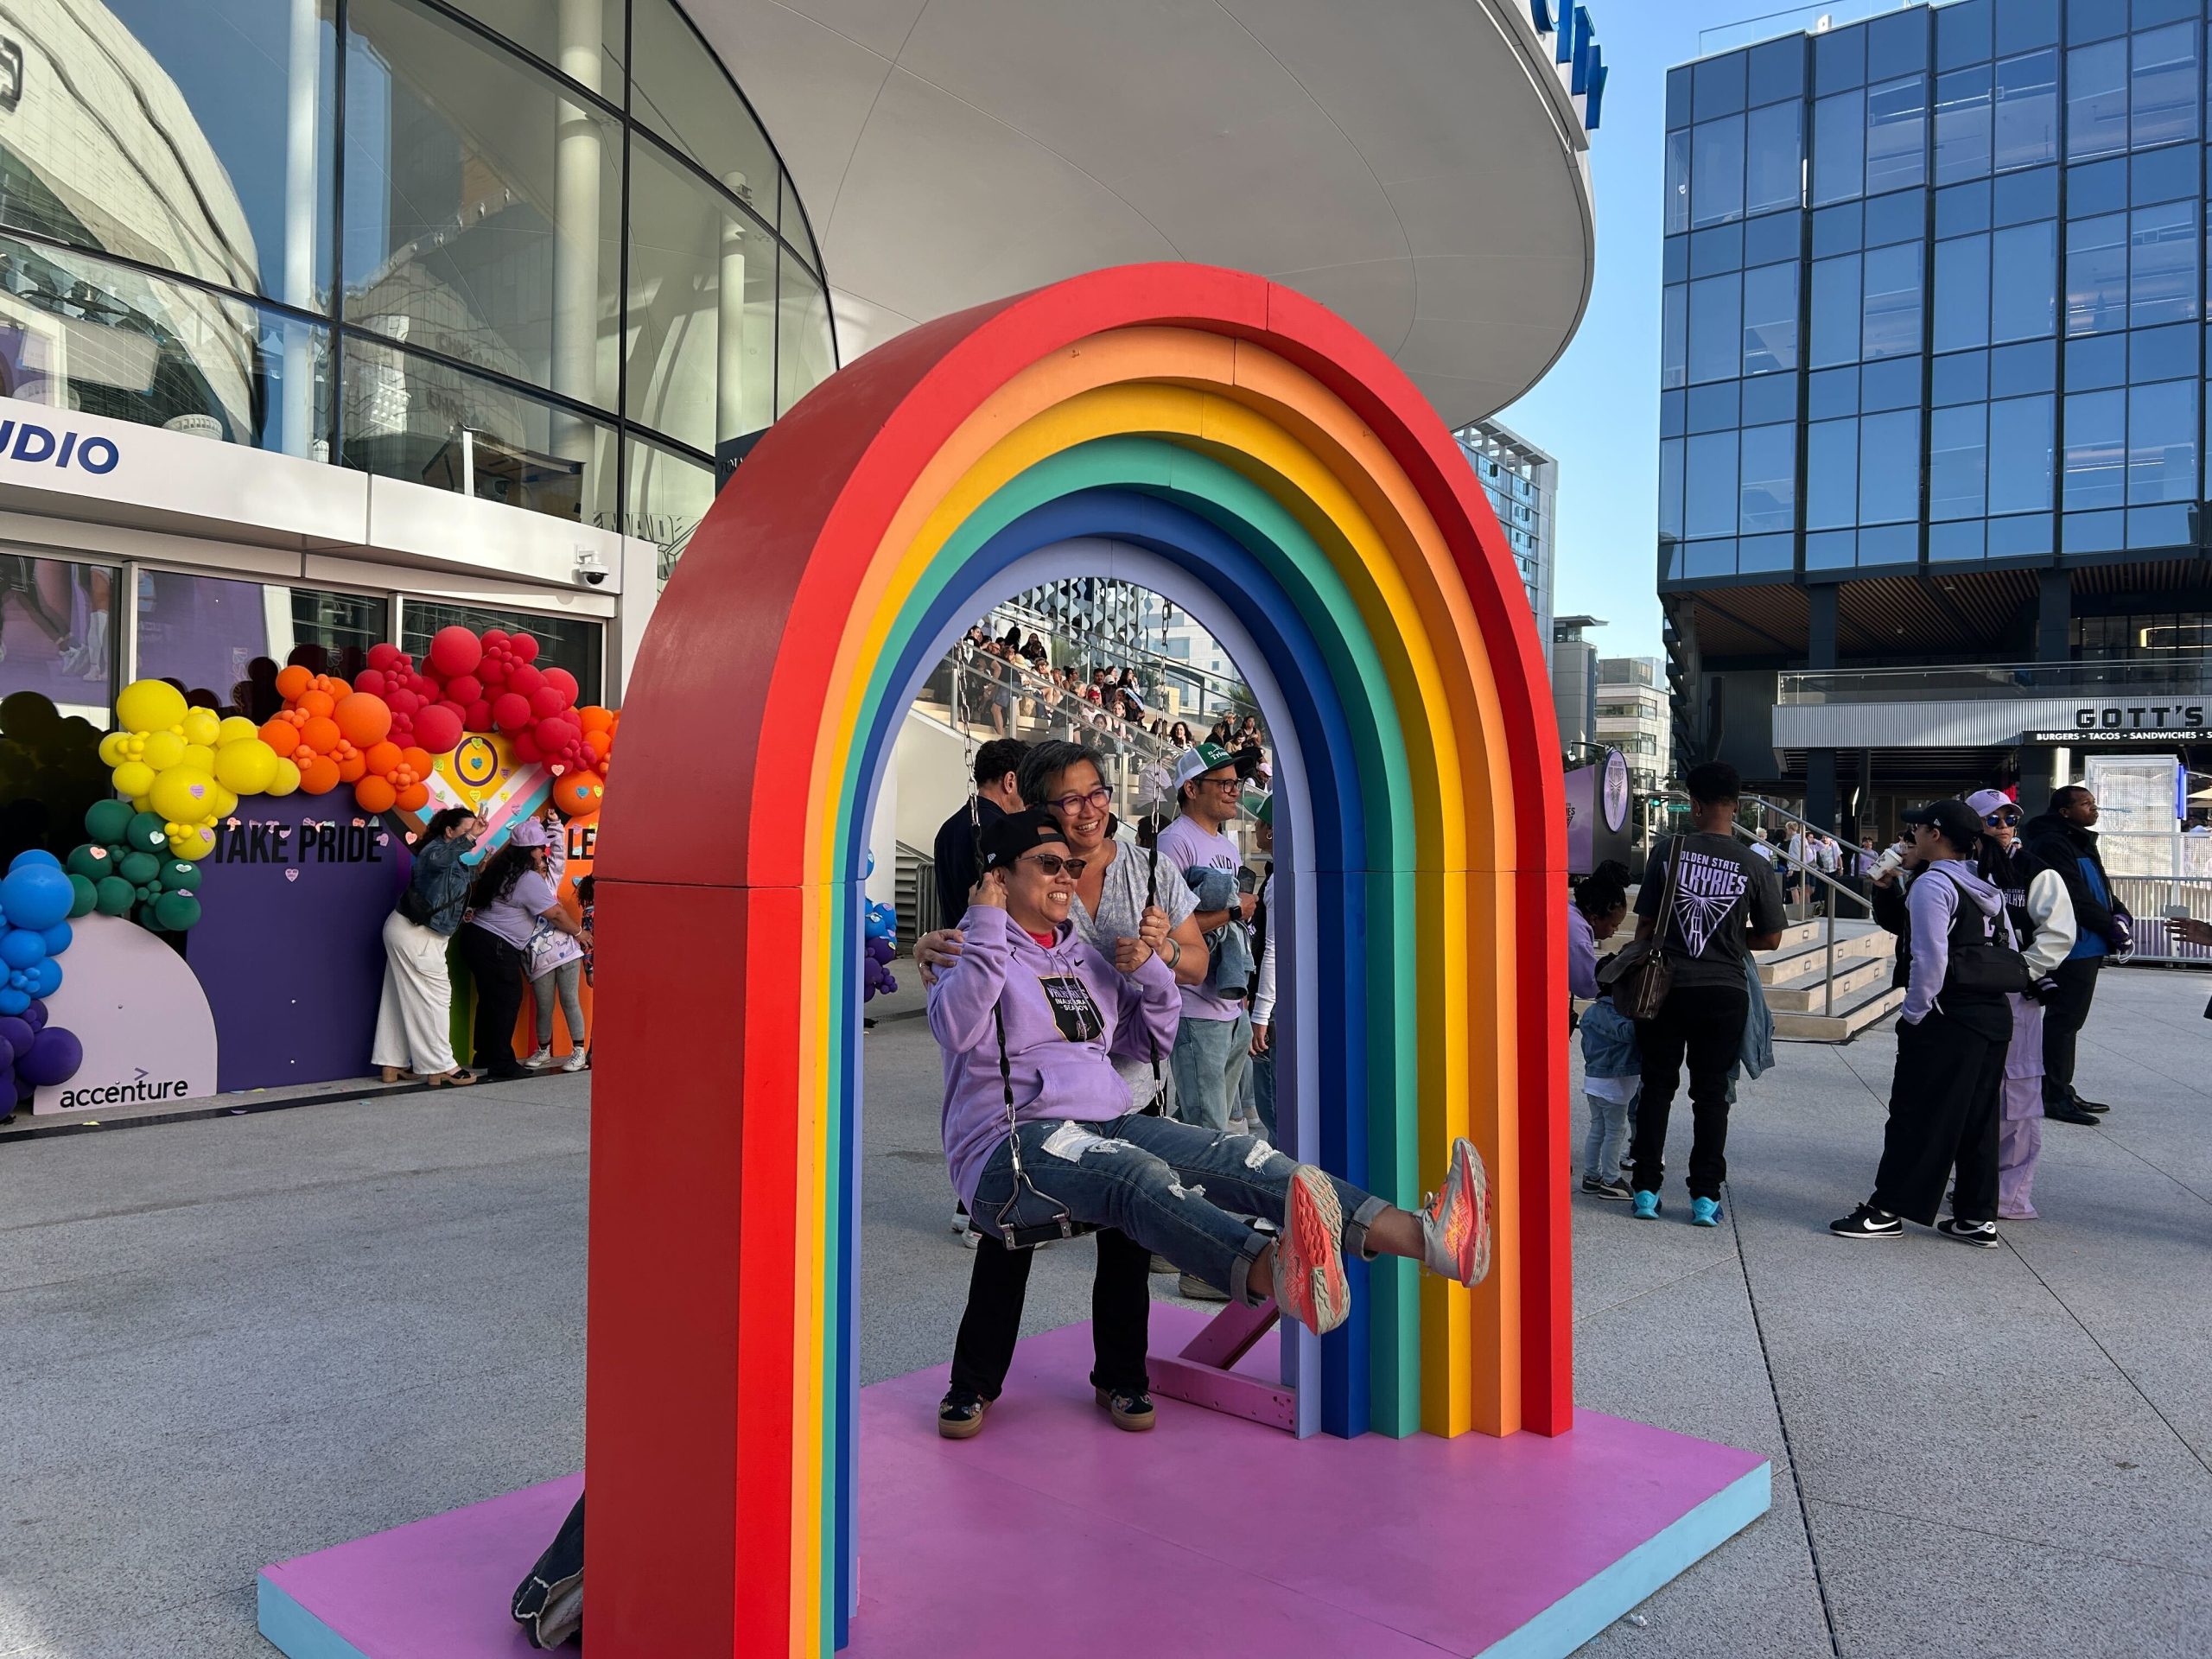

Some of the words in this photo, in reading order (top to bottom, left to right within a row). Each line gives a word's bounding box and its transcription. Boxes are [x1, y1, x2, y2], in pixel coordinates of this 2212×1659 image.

[2075, 705, 2203, 728] GOTT'S
[215, 824, 291, 863] TAKE
[298, 825, 384, 863] PRIDE
[1680, 850, 1710, 865] OLDEN
[1711, 857, 1741, 873] STATE
[60, 1079, 188, 1109] accenture
